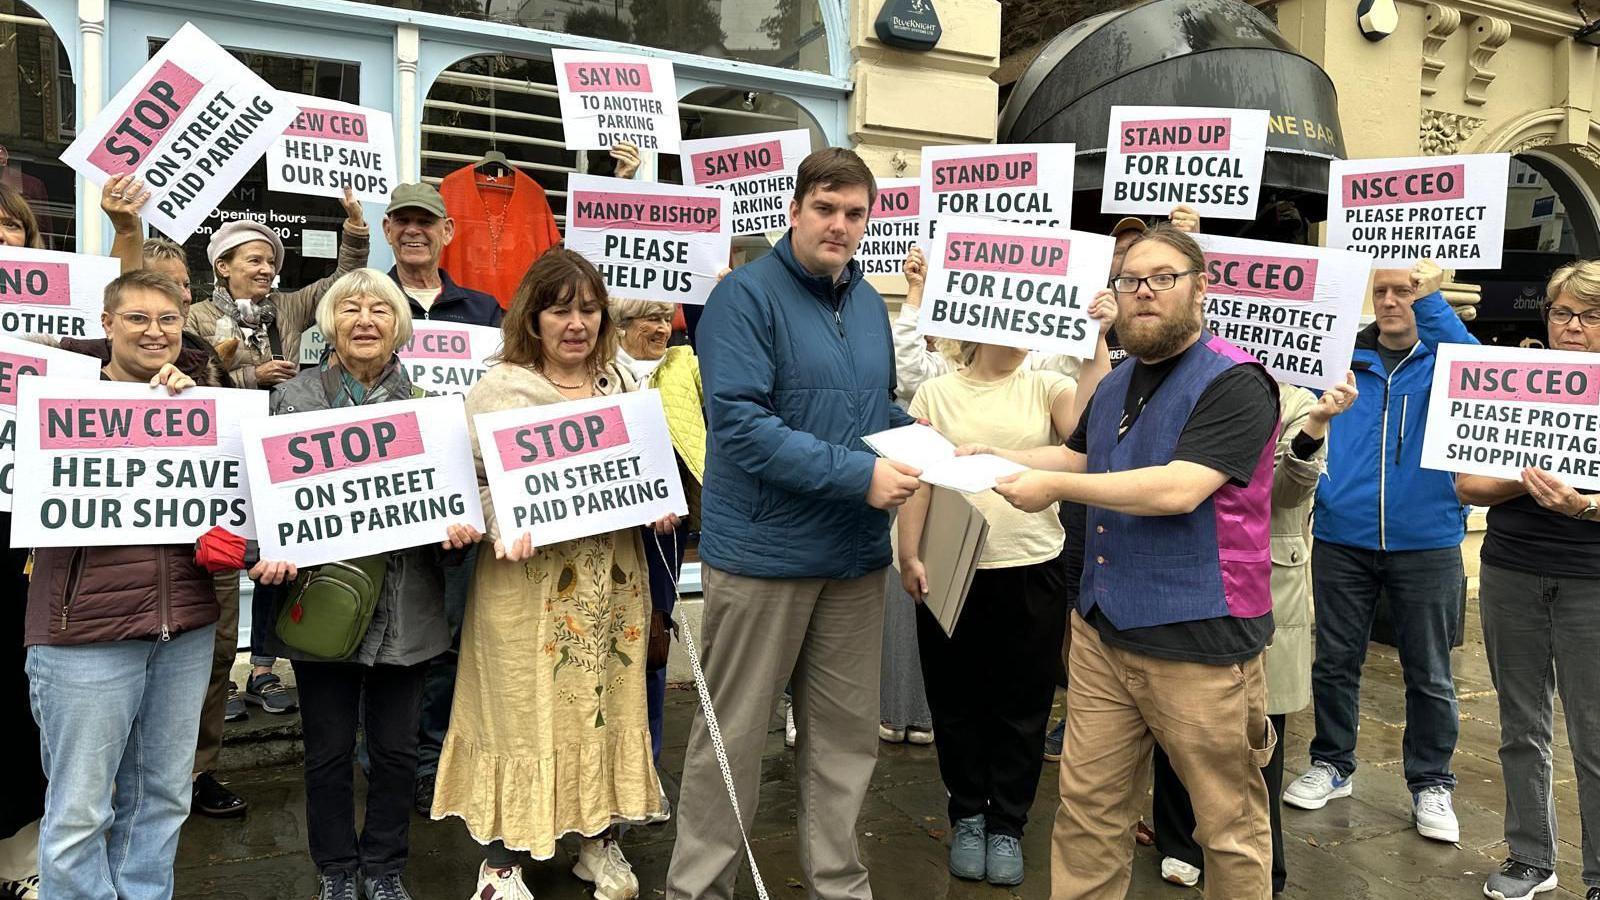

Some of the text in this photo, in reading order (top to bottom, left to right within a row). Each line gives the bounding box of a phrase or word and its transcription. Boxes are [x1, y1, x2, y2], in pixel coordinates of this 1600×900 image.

[578, 67, 641, 86] SAY NO
[580, 95, 663, 114] TO ANOTHER
[105, 80, 181, 166] STOP
[289, 112, 364, 137] EW CEO
[597, 114, 654, 131] PARKING
[1124, 125, 1226, 147] STAND UP
[1268, 115, 1336, 147] NE BAR
[145, 90, 236, 188] ON STREET
[598, 132, 658, 149] DISASTER
[156, 95, 274, 220] PAID PARKING
[285, 139, 382, 171] HELP SAVE
[704, 147, 771, 177] SAY NO
[1125, 155, 1243, 179] FOR LOCAL
[281, 164, 388, 195] OUR SHOPS
[730, 176, 794, 197] ANOTHER
[935, 160, 1033, 186] STAND UP
[1351, 171, 1454, 200] NSC CEO
[732, 195, 783, 215] ARKING
[880, 191, 910, 212] NO
[937, 192, 1053, 213] FOR LOCAL
[1114, 181, 1249, 206] BUSINESSES
[208, 208, 307, 224] Opening hours
[577, 200, 718, 225] MANDY BISHOP
[732, 213, 787, 234] ISASTER
[1345, 206, 1487, 223] PLEASE PROTECT
[194, 226, 213, 234] on
[276, 227, 290, 239] 30
[863, 222, 920, 237] ANOTHE
[1352, 225, 1477, 241] OUR HERITAGE
[604, 234, 689, 264] PLEASE
[948, 240, 1063, 268] STAND UP
[1435, 243, 1481, 259] AREA
[597, 263, 692, 293] HELP US
[861, 259, 906, 274] ISAST
[1207, 260, 1304, 292] SC CEO
[0, 268, 49, 296] NO
[946, 270, 1081, 310] FOR LOCAL
[1, 311, 86, 337] OTHER
[931, 299, 1087, 341] BUSINESSES
[1204, 297, 1244, 318] ASE
[1246, 303, 1337, 332] PROTECT
[422, 334, 466, 354] CEO
[1224, 322, 1323, 354] HERITAGE
[1271, 352, 1323, 377] AREA
[1460, 367, 1588, 396] NSC CEO
[47, 408, 133, 438] NEW
[143, 408, 210, 438] CEO
[1450, 401, 1600, 432] PLEASE PROTE
[287, 421, 397, 474] STOP
[515, 415, 605, 463] STOP
[1456, 423, 1600, 455] OUR HERITAG
[52, 456, 240, 489] HELP SAVE
[1446, 443, 1600, 477] SHOPPING ARE
[294, 467, 436, 511] ON STREET
[525, 455, 641, 496] ON STREET
[40, 498, 247, 529] OUR SHOPS
[513, 478, 669, 528] PAID PARKING
[277, 493, 465, 547] PAID PARKING
